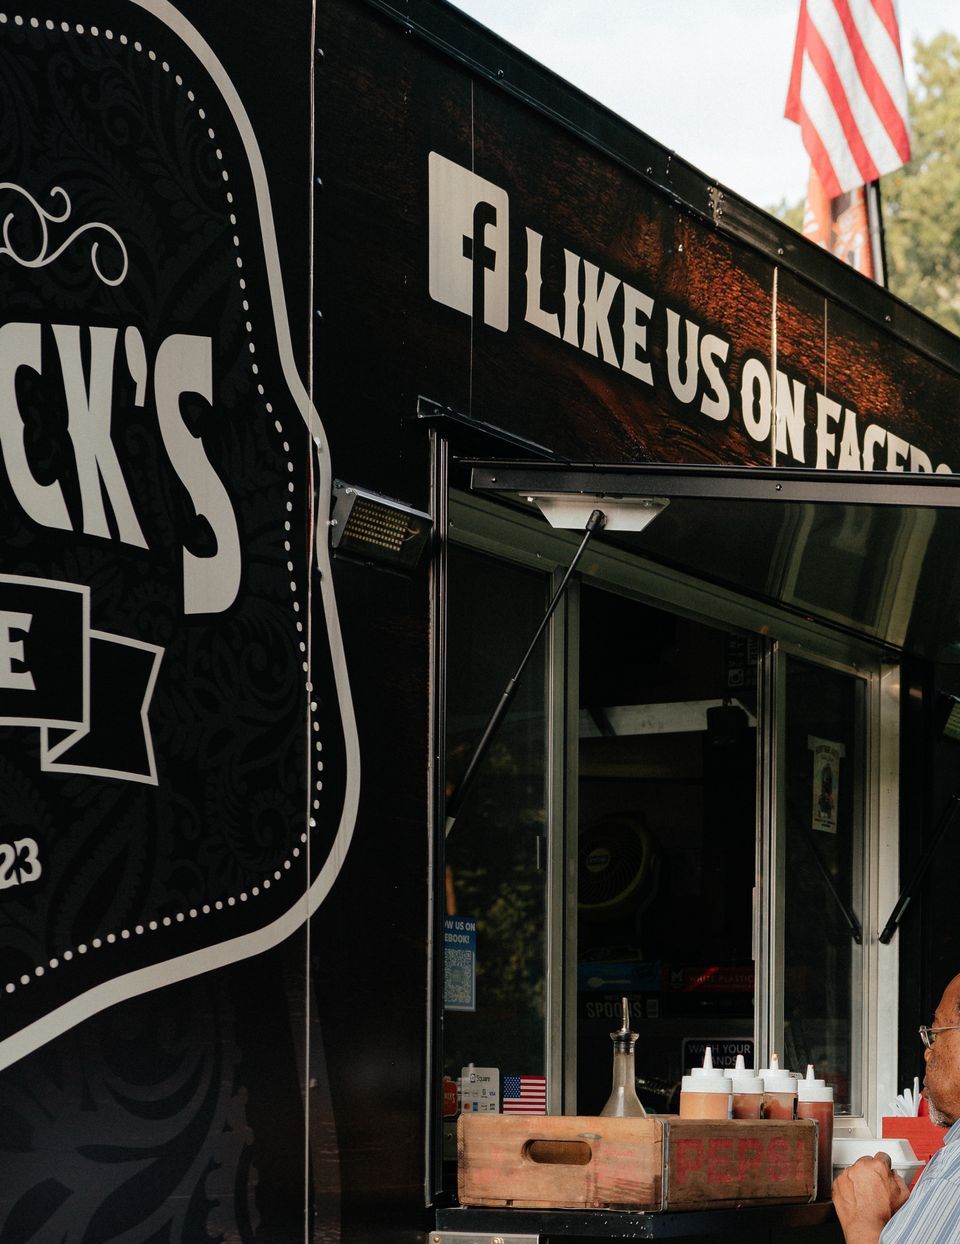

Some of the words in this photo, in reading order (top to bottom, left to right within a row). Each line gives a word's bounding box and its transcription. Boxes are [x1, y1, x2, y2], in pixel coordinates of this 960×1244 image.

[524, 226, 655, 387] LIKE
[665, 302, 730, 422] US
[740, 356, 807, 465] ON
[816, 392, 953, 475] FACE
[0, 322, 242, 615] CK'S
[455, 921, 464, 931] US
[465, 922, 476, 932] ON
[688, 1043, 719, 1054] WAH
[722, 1043, 751, 1054] YOUR
[701, 1056, 737, 1066] ANDS
[674, 1136, 805, 1185] PEPSI
